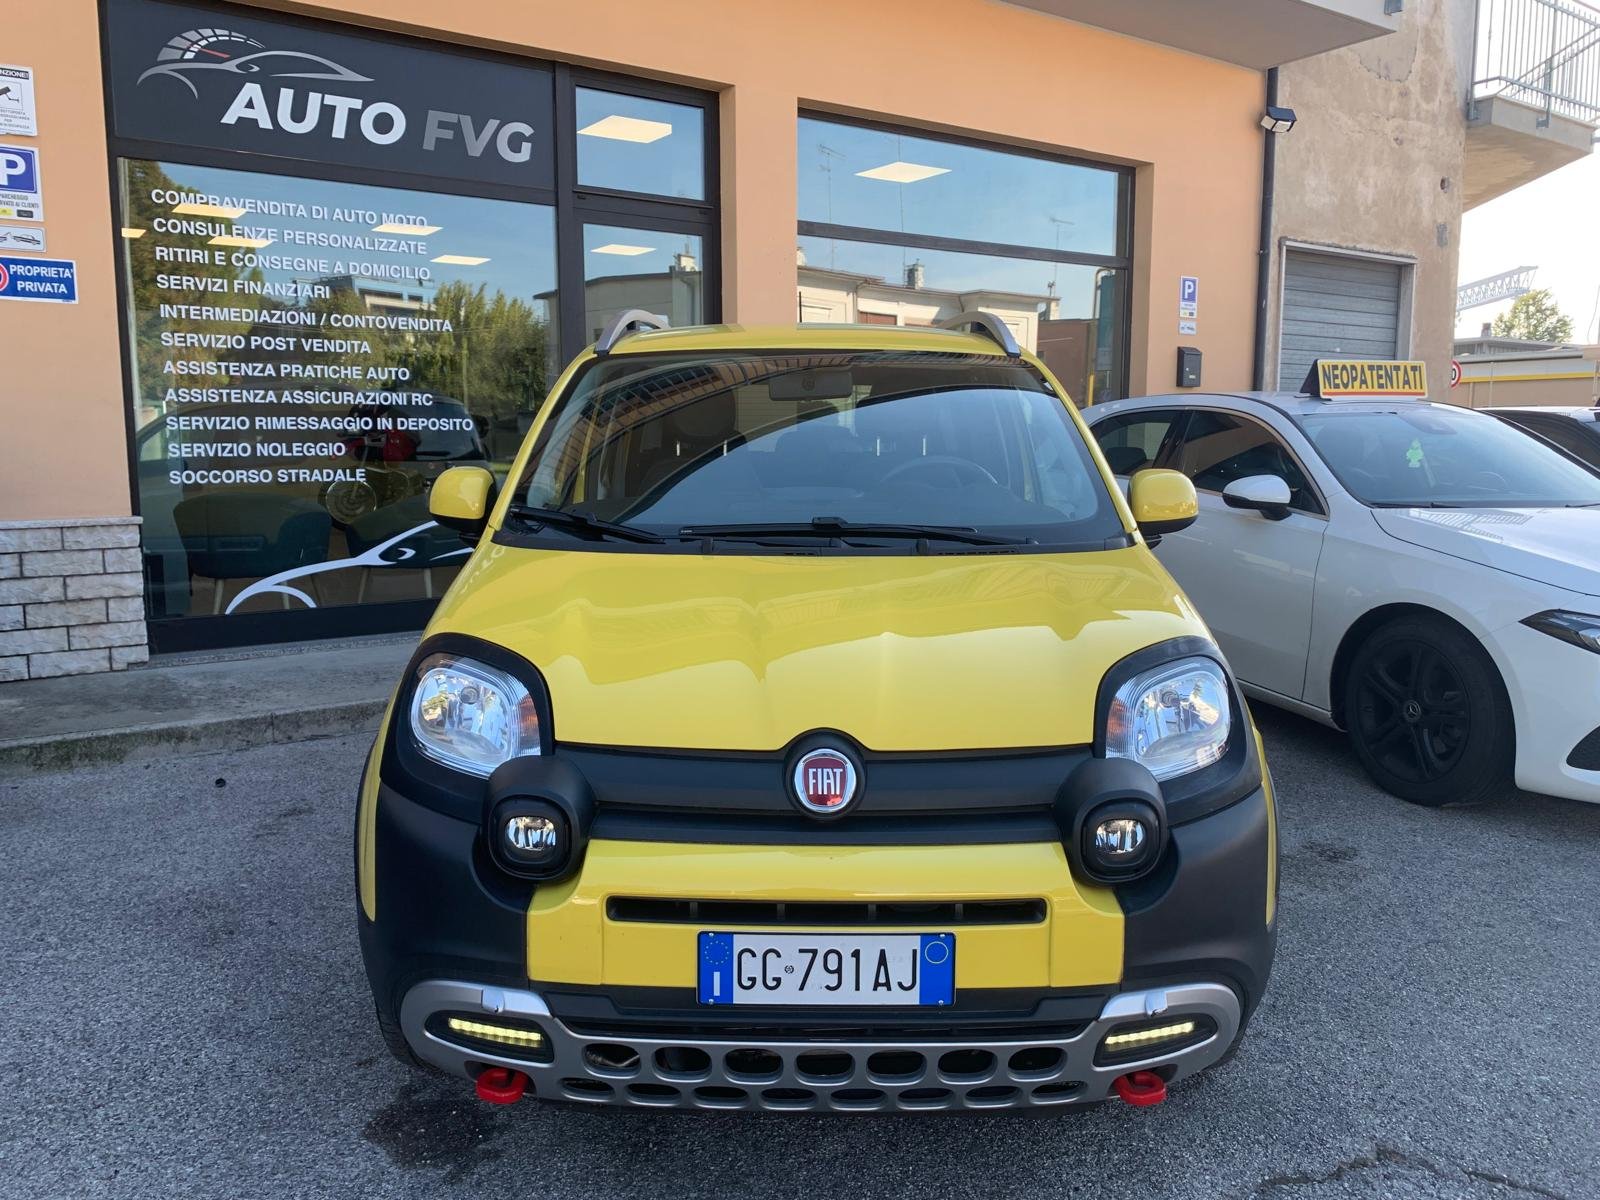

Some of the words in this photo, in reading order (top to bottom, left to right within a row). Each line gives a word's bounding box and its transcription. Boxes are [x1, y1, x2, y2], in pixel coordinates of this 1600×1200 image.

[220, 82, 406, 145] AUTO
[422, 110, 534, 163] FVG
[0, 152, 26, 186] P
[151, 189, 307, 219] COMPRAVENDITA
[311, 205, 328, 220] DI
[332, 208, 377, 225] AUTO
[382, 212, 427, 227] MOTO
[153, 217, 278, 242] CONSULENZE
[283, 229, 427, 255] PERSONALIZZATE
[9, 264, 73, 279] PROPRIETA'
[155, 246, 209, 264] RITIRI
[214, 251, 227, 266] E
[231, 252, 329, 273] CONSEGNE
[333, 261, 345, 274] A
[349, 262, 431, 280] DOMICILIO
[17, 280, 68, 294] PRIVATA
[156, 274, 228, 293] SERVIZI
[233, 279, 330, 299] FINANZIARI
[1184, 280, 1194, 299] P
[160, 303, 316, 326] INTERMEDIAZIONI
[320, 313, 327, 326] /
[330, 313, 453, 332] CONTOVENDITA
[161, 331, 245, 349] SERVIZIO
[251, 336, 296, 351] POST
[301, 338, 371, 354] VENDITA
[163, 360, 276, 377] ASSISTENZA
[281, 363, 362, 379] PRATICHE
[367, 366, 410, 381] AUTO
[1322, 364, 1423, 390] NEOPATENTATI
[165, 388, 277, 403] ASSISTENZA
[281, 390, 407, 405] ASSICURAZIONI
[411, 393, 433, 406] RC
[166, 416, 250, 431] SERVIZIO
[255, 416, 373, 431] RIMESSAGGIO
[377, 417, 392, 430] IN
[397, 417, 474, 431] DEPOSITO
[168, 442, 252, 458] SERVIZIO
[256, 442, 346, 458] NOLEGGIO
[169, 469, 273, 485] SOCCORSO
[277, 468, 366, 484] STRADALE
[808, 768, 843, 795] FIAT
[737, 948, 782, 990] GG
[798, 948, 918, 992] 791AJ
